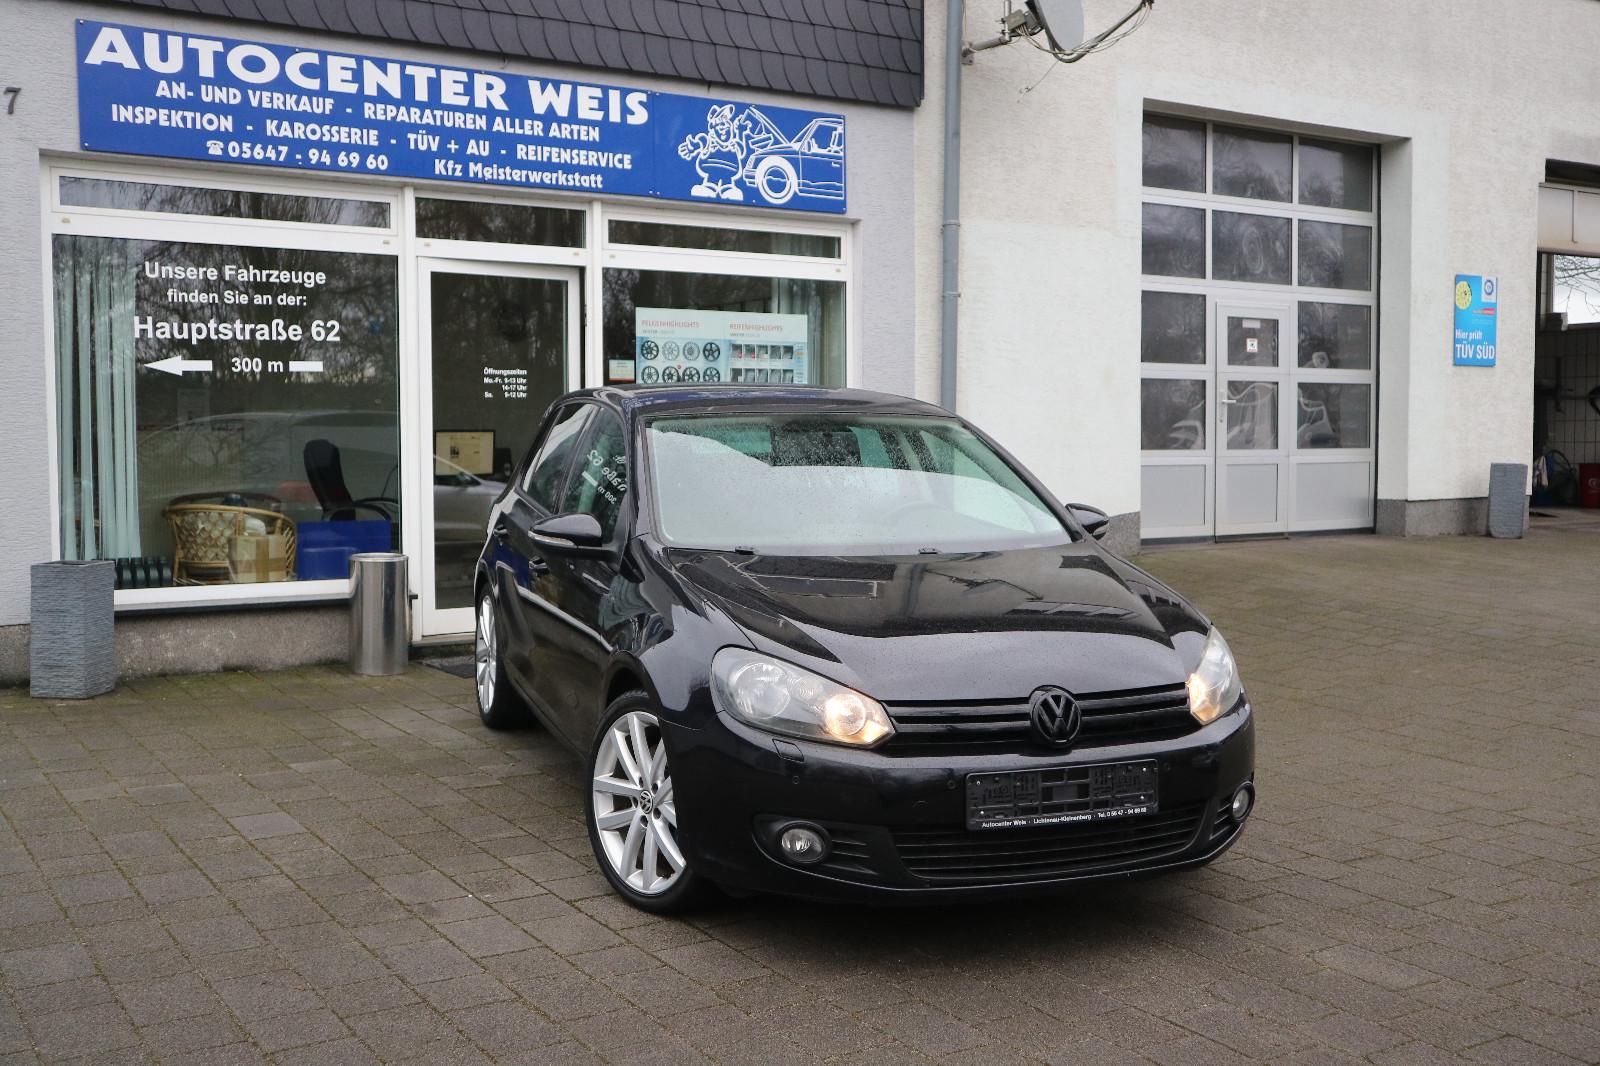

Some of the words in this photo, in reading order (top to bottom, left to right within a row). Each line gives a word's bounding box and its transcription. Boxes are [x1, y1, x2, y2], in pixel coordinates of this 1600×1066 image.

[84, 27, 508, 111] AUTOCENTER
[527, 80, 649, 125] WEIS
[4, 87, 22, 115] 7
[155, 79, 194, 100] AN-
[200, 85, 242, 105] UND
[247, 89, 334, 115] VERKAUF
[364, 101, 487, 131] REPARATUREN
[492, 117, 544, 137] ALLER
[548, 122, 600, 141] ARTEN
[111, 103, 234, 133] INSPEKTION
[265, 119, 379, 147] KAROSSERIE
[407, 131, 440, 152] TÜV
[447, 141, 460, 154] +
[466, 138, 490, 157] AU
[516, 142, 633, 170] REIFENSERVICE
[228, 144, 288, 163] 05647
[308, 148, 332, 167] 94
[337, 151, 360, 169] 69
[366, 153, 389, 171] 60
[434, 158, 463, 178] Kfz
[468, 161, 604, 189] Meisterwerkstatt
[144, 261, 218, 280] Unsere
[224, 264, 326, 288] Fahrzeuge
[167, 288, 219, 304] finden
[223, 290, 249, 305] Sie
[253, 294, 272, 305] an
[277, 293, 307, 306] der:
[133, 315, 303, 344] Hauptstraße
[310, 320, 341, 342] 62
[1455, 329, 1468, 339] Hier
[1455, 341, 1474, 358] TÜV
[1476, 342, 1495, 360] SÜD
[231, 357, 262, 373] 300
[268, 360, 284, 373] m
